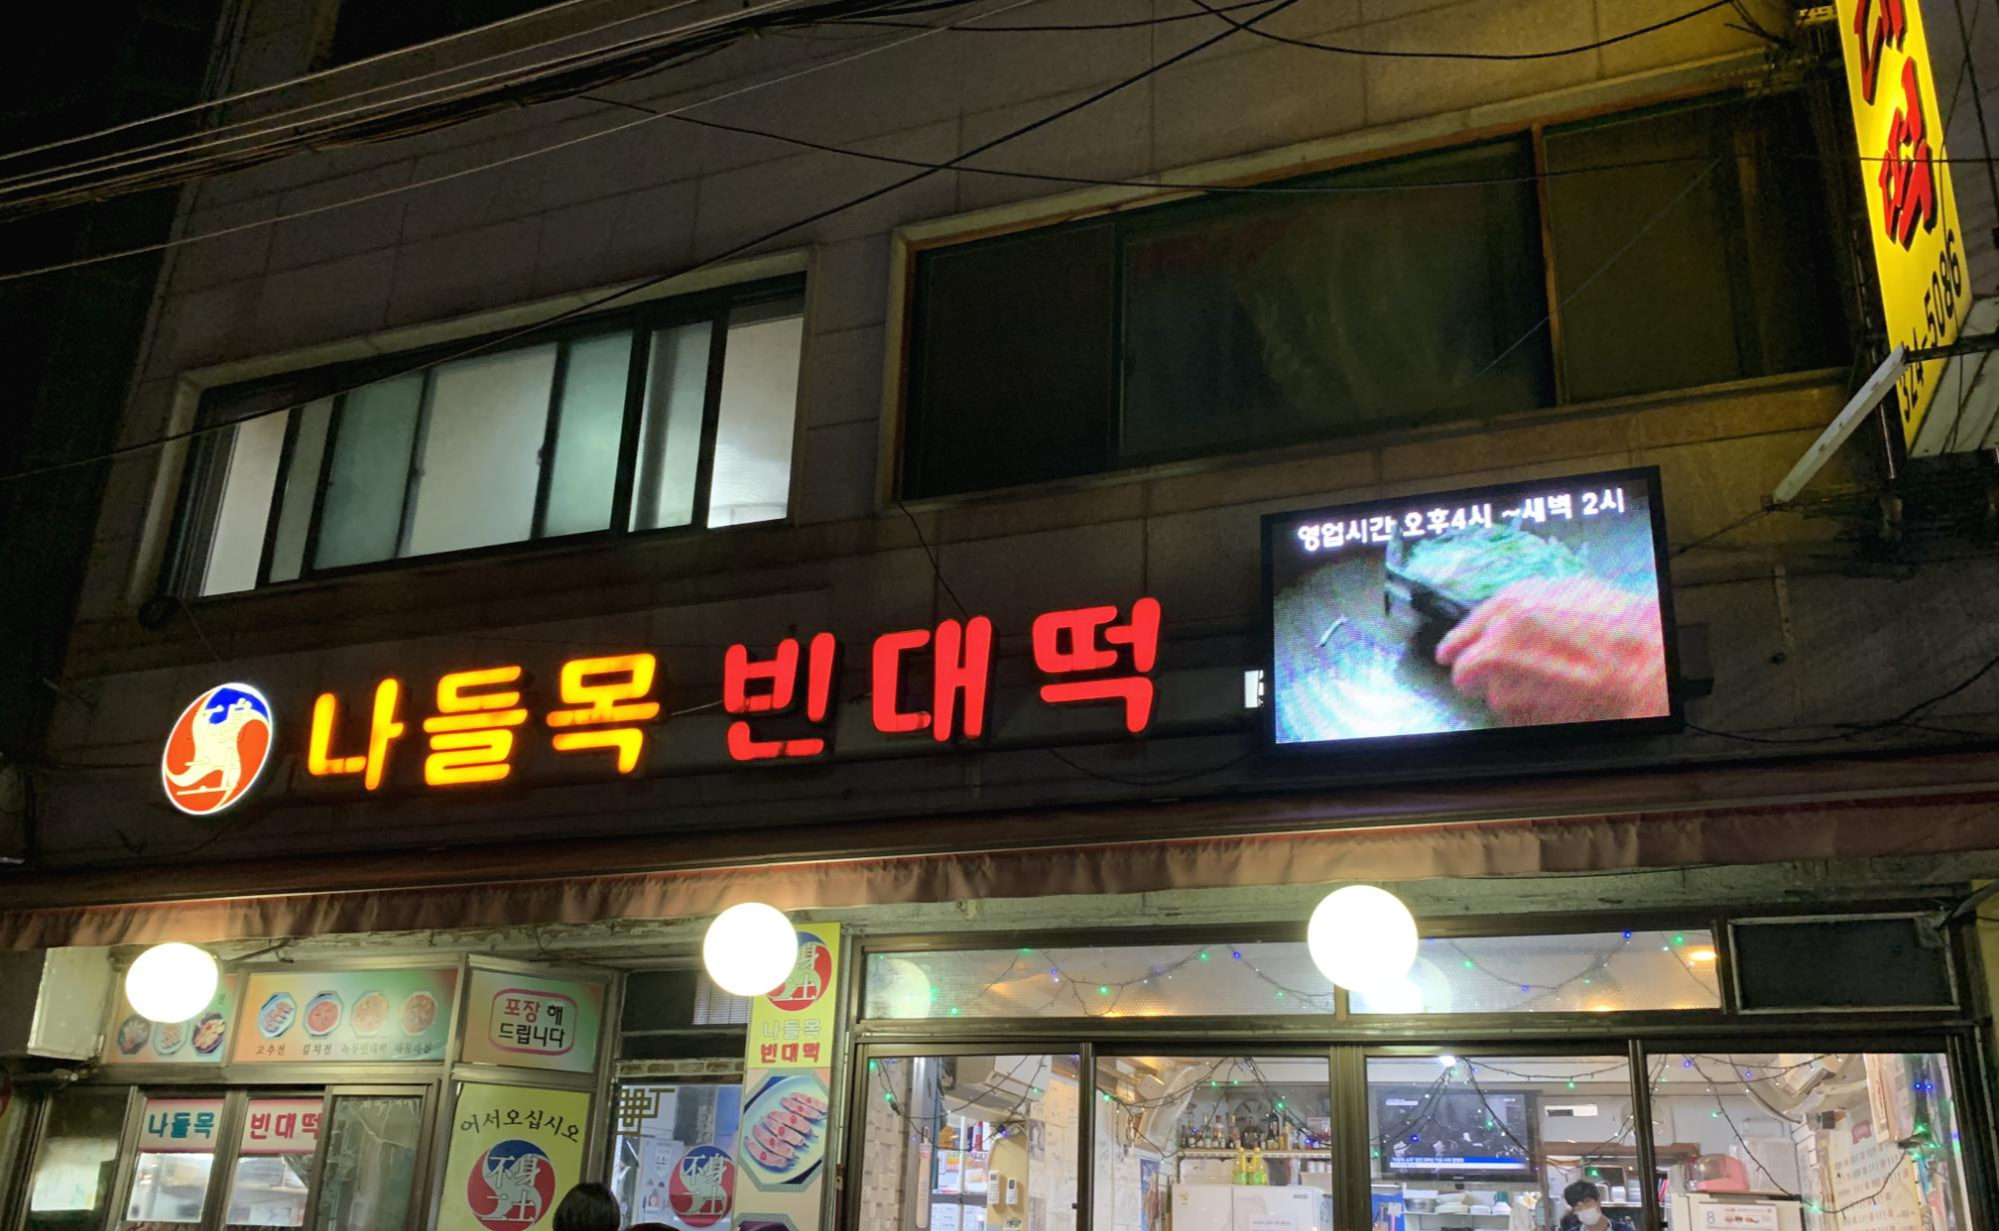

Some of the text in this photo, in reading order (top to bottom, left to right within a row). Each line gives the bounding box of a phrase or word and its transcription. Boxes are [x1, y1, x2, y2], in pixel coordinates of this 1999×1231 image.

[1298, 516, 1397, 551] 영업시간
[1403, 503, 1492, 537] 오후4시
[1582, 488, 1625, 516] 2시
[308, 597, 1162, 791] 나들목 빈대떡
[504, 998, 542, 1023] 포장
[498, 1022, 566, 1049] 드립니다
[763, 1018, 821, 1041] 나들목
[761, 1042, 821, 1064] 빈대떡
[147, 1111, 323, 1140] 나들목 빈대떡
[461, 1109, 580, 1143] 어서오십시오
